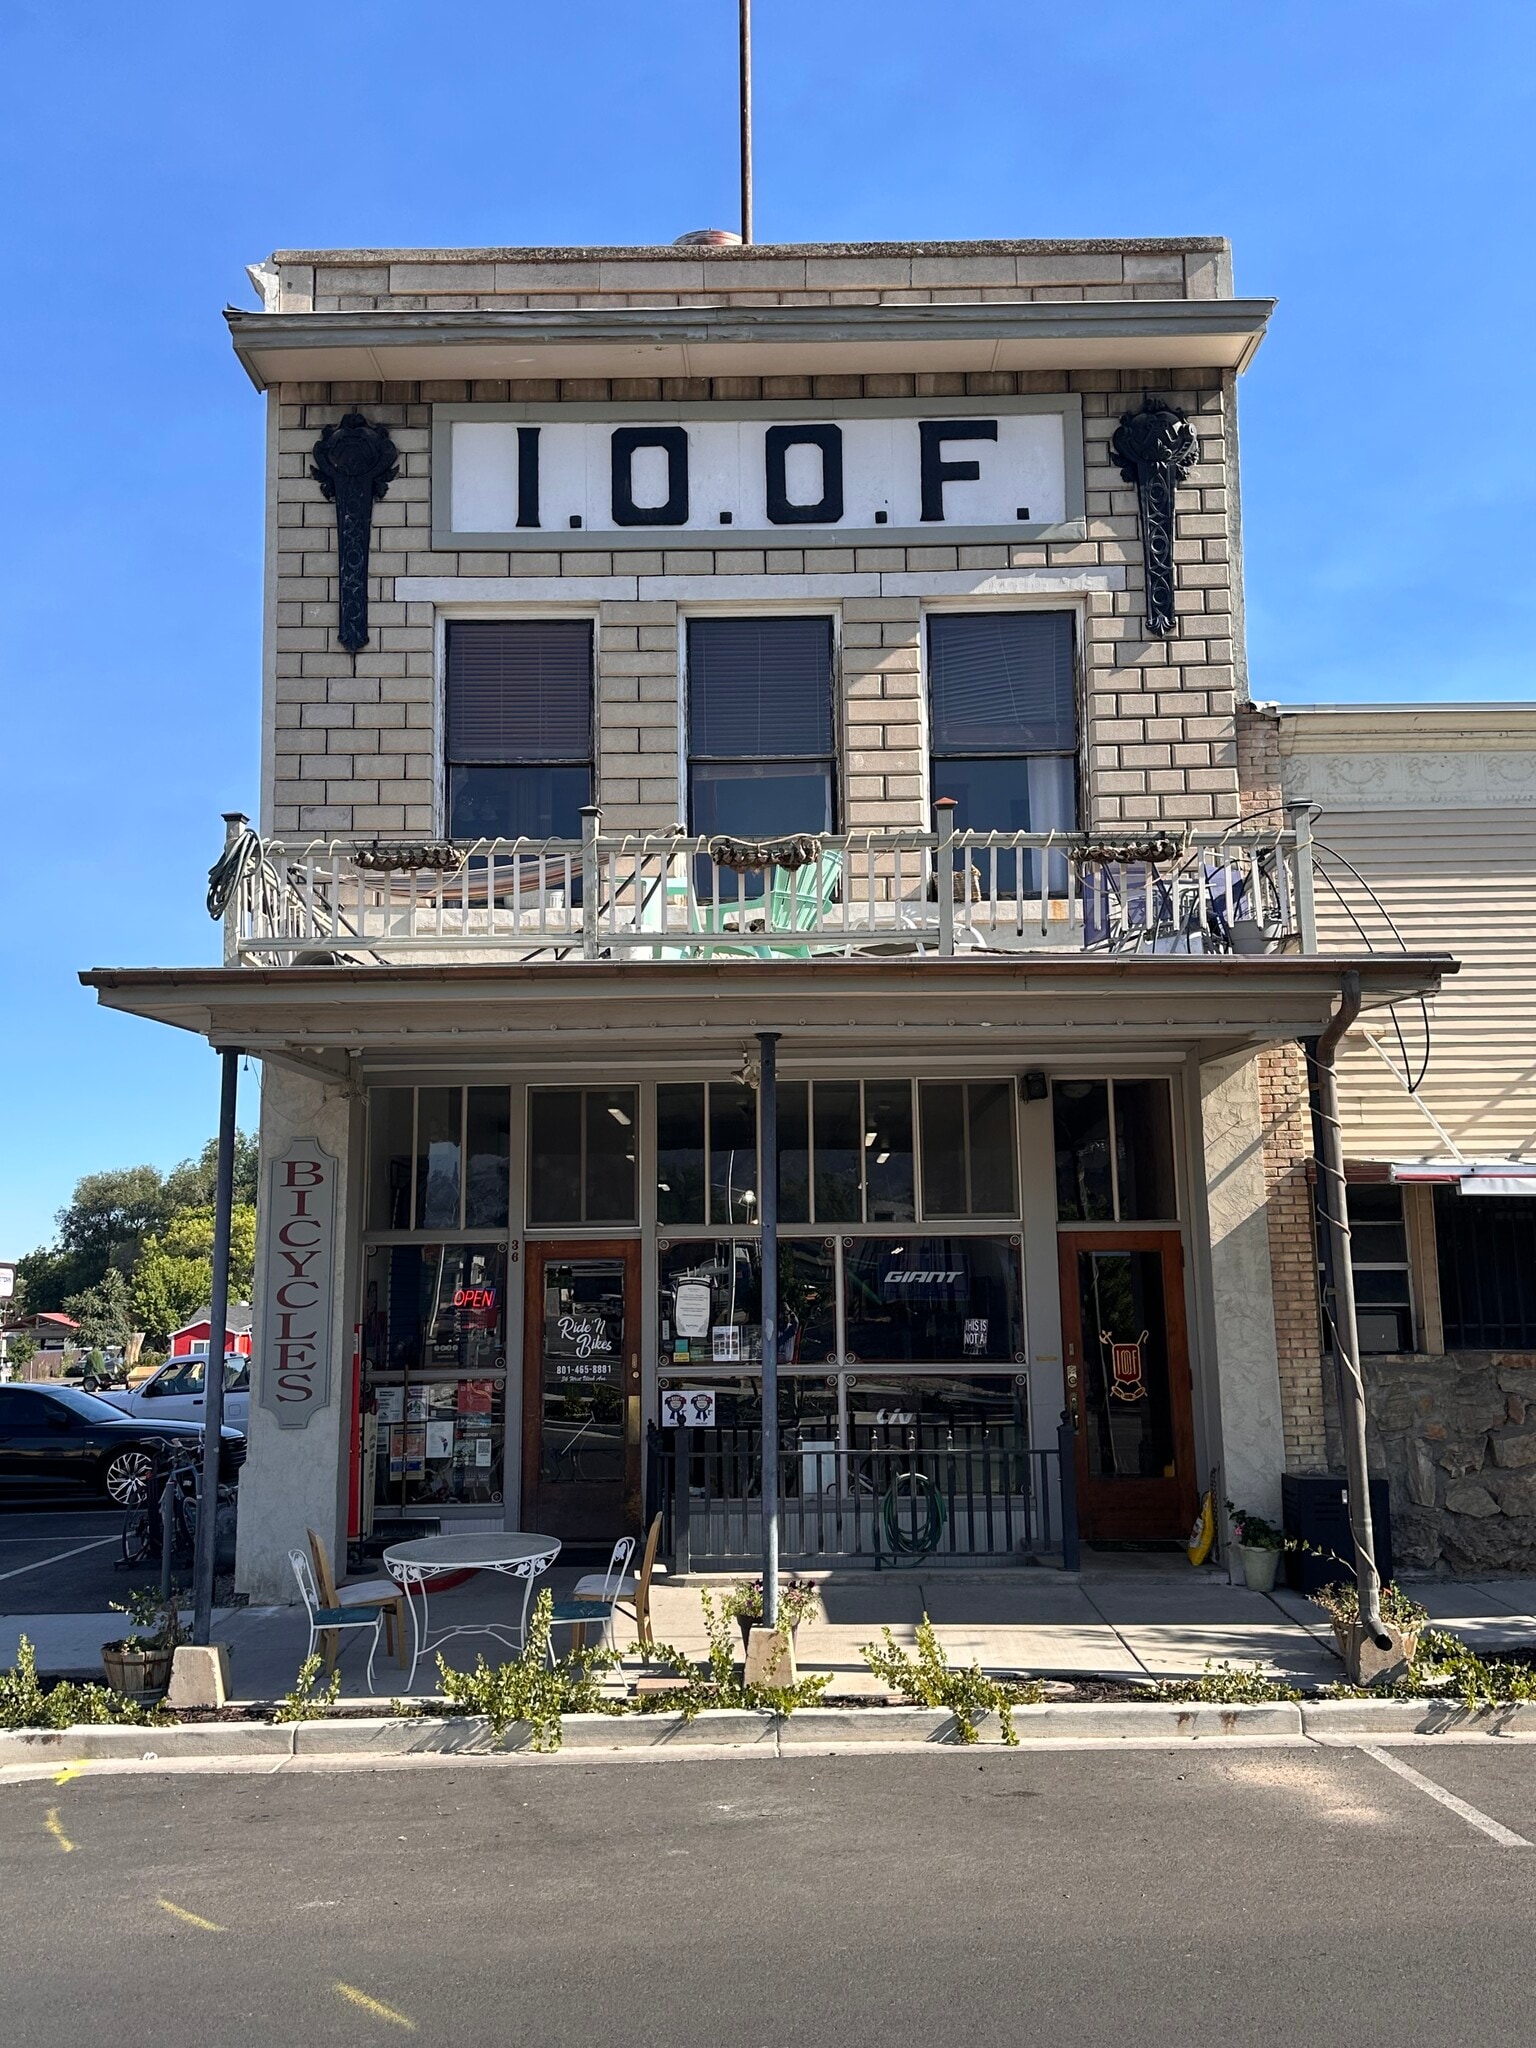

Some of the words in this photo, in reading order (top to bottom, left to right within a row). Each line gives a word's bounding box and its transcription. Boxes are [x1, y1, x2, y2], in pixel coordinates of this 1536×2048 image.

[515, 419, 1029, 529] I.O.O.F.
[511, 1240, 519, 1263] 36
[272, 1160, 325, 1403] BICYCLES
[884, 1271, 964, 1283] GIANT
[453, 1290, 494, 1307] OPEN
[557, 1316, 591, 1340] Ride
[964, 1320, 979, 1332] THIS
[980, 1320, 987, 1332] IS
[576, 1333, 613, 1358] Bikes
[964, 1333, 978, 1345] NOT
[556, 1365, 611, 1375] 801-465-8881
